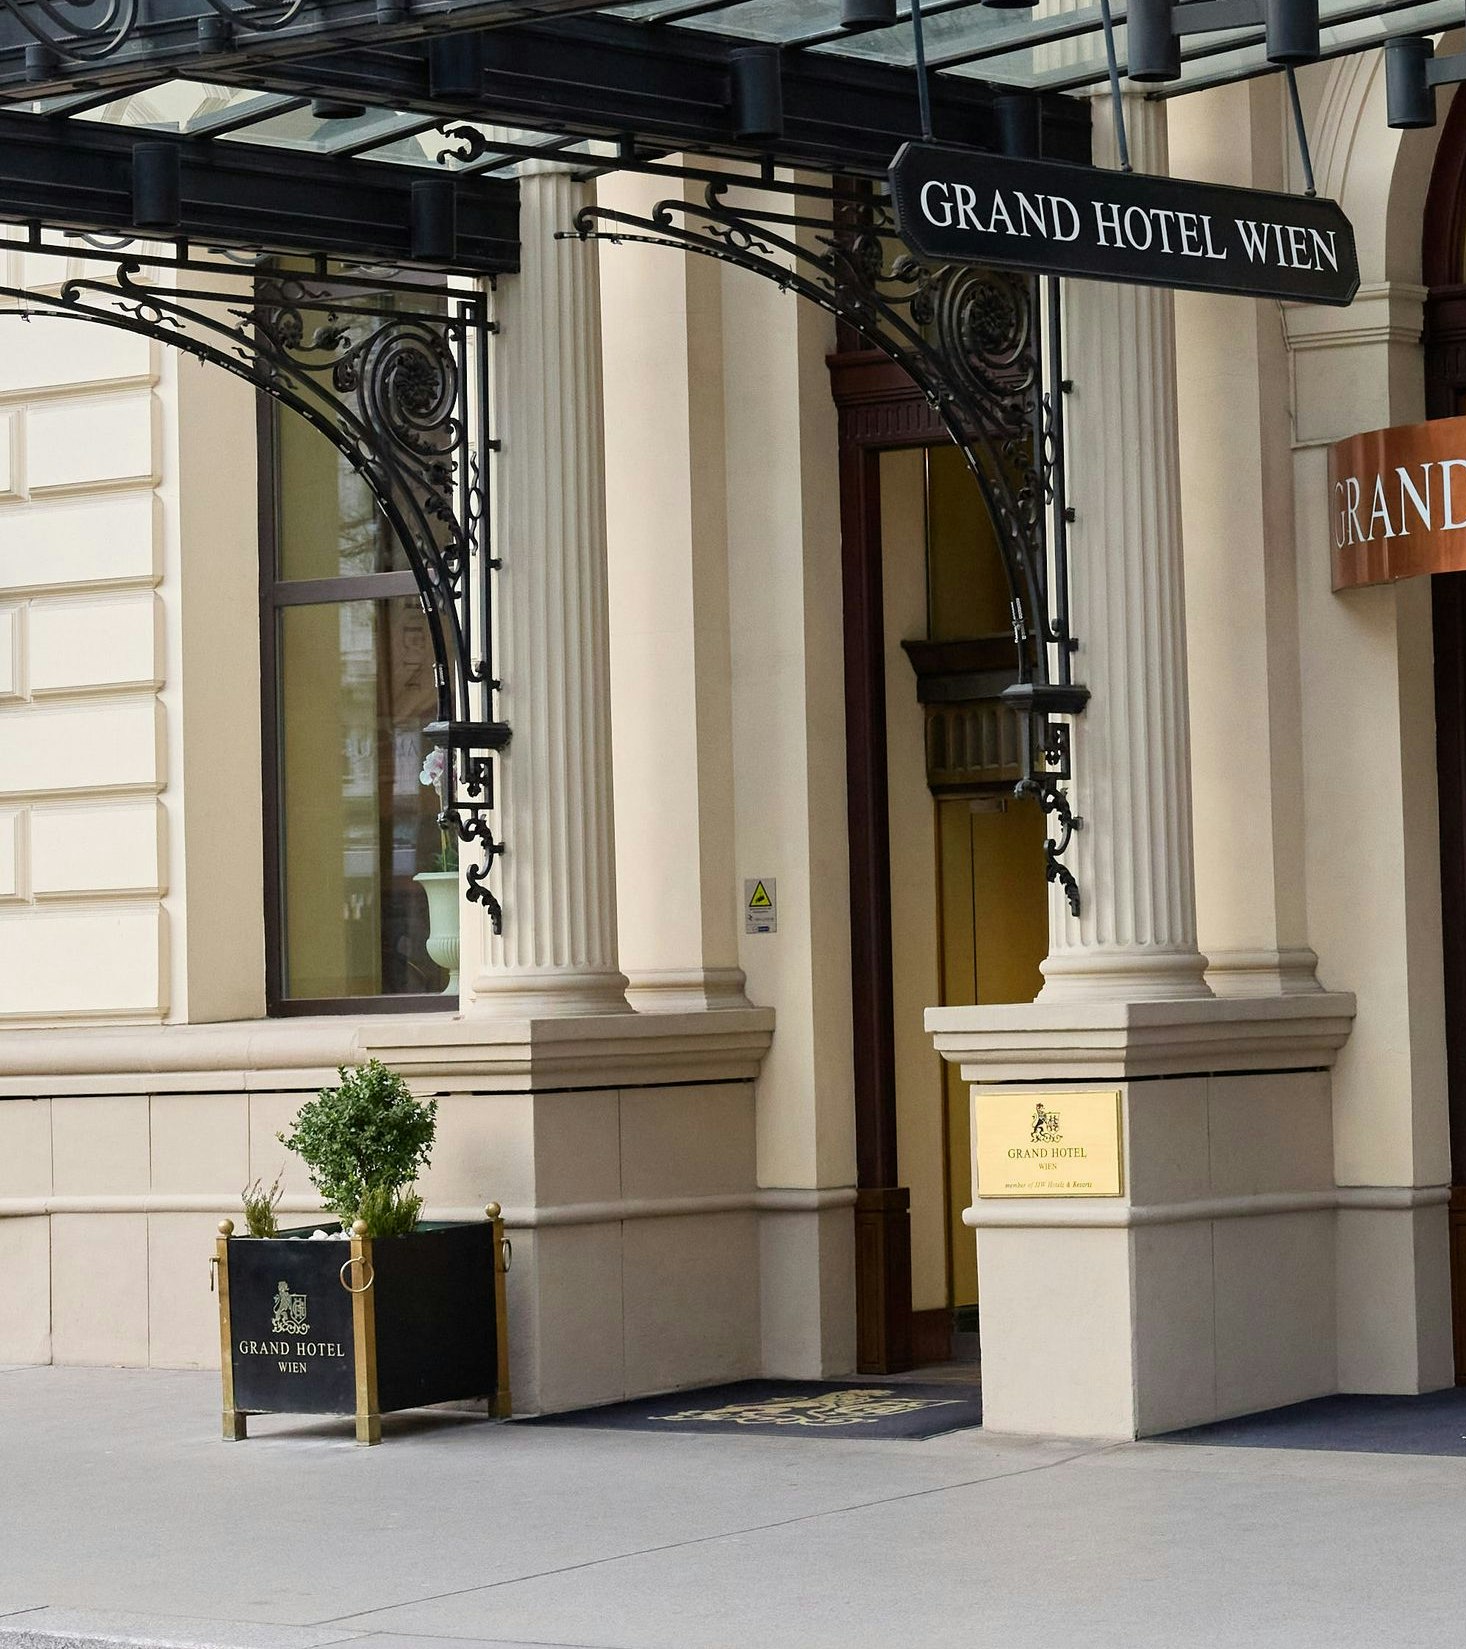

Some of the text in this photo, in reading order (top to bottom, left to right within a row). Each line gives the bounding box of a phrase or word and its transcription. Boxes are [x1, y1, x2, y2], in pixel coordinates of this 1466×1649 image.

[920, 180, 1339, 273] GRAND HOTEL WIEN
[1008, 1147, 1088, 1158] GRAND HOTEL
[1038, 1162, 1057, 1170] WIEN
[239, 1340, 345, 1357] GRAND HOTEL
[278, 1361, 307, 1374] WIEN
